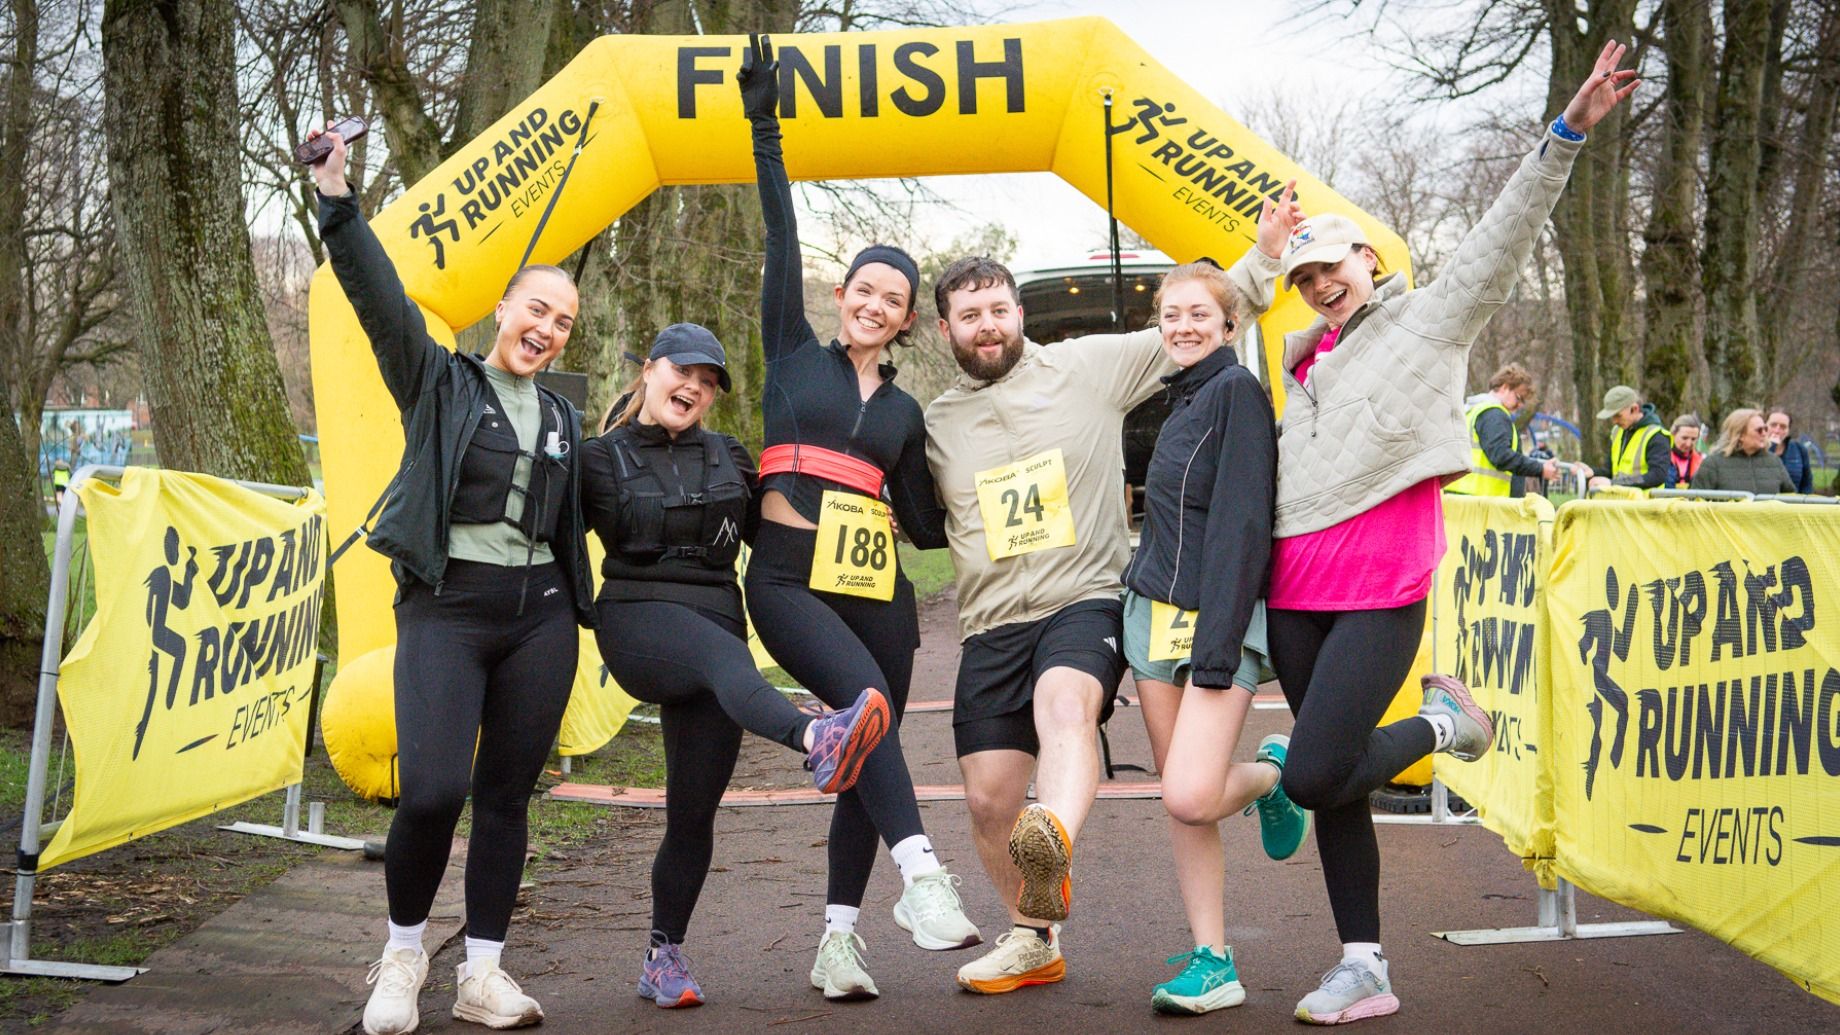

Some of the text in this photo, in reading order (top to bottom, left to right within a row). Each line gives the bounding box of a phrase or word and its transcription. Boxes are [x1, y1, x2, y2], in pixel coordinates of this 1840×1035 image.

[450, 107, 548, 195] UP AND
[1187, 127, 1234, 160] UP
[459, 109, 582, 231] RUNNING
[511, 160, 567, 218] EVENTS
[1173, 186, 1240, 233] EVENTS
[1025, 459, 1052, 473] SCULPT
[1001, 483, 1045, 528] 24
[207, 513, 321, 609] UP AND
[835, 524, 887, 571] 188
[846, 580, 876, 588] RUNNING
[1641, 556, 1815, 670] UP AND
[1676, 806, 1784, 866] EVENTS
